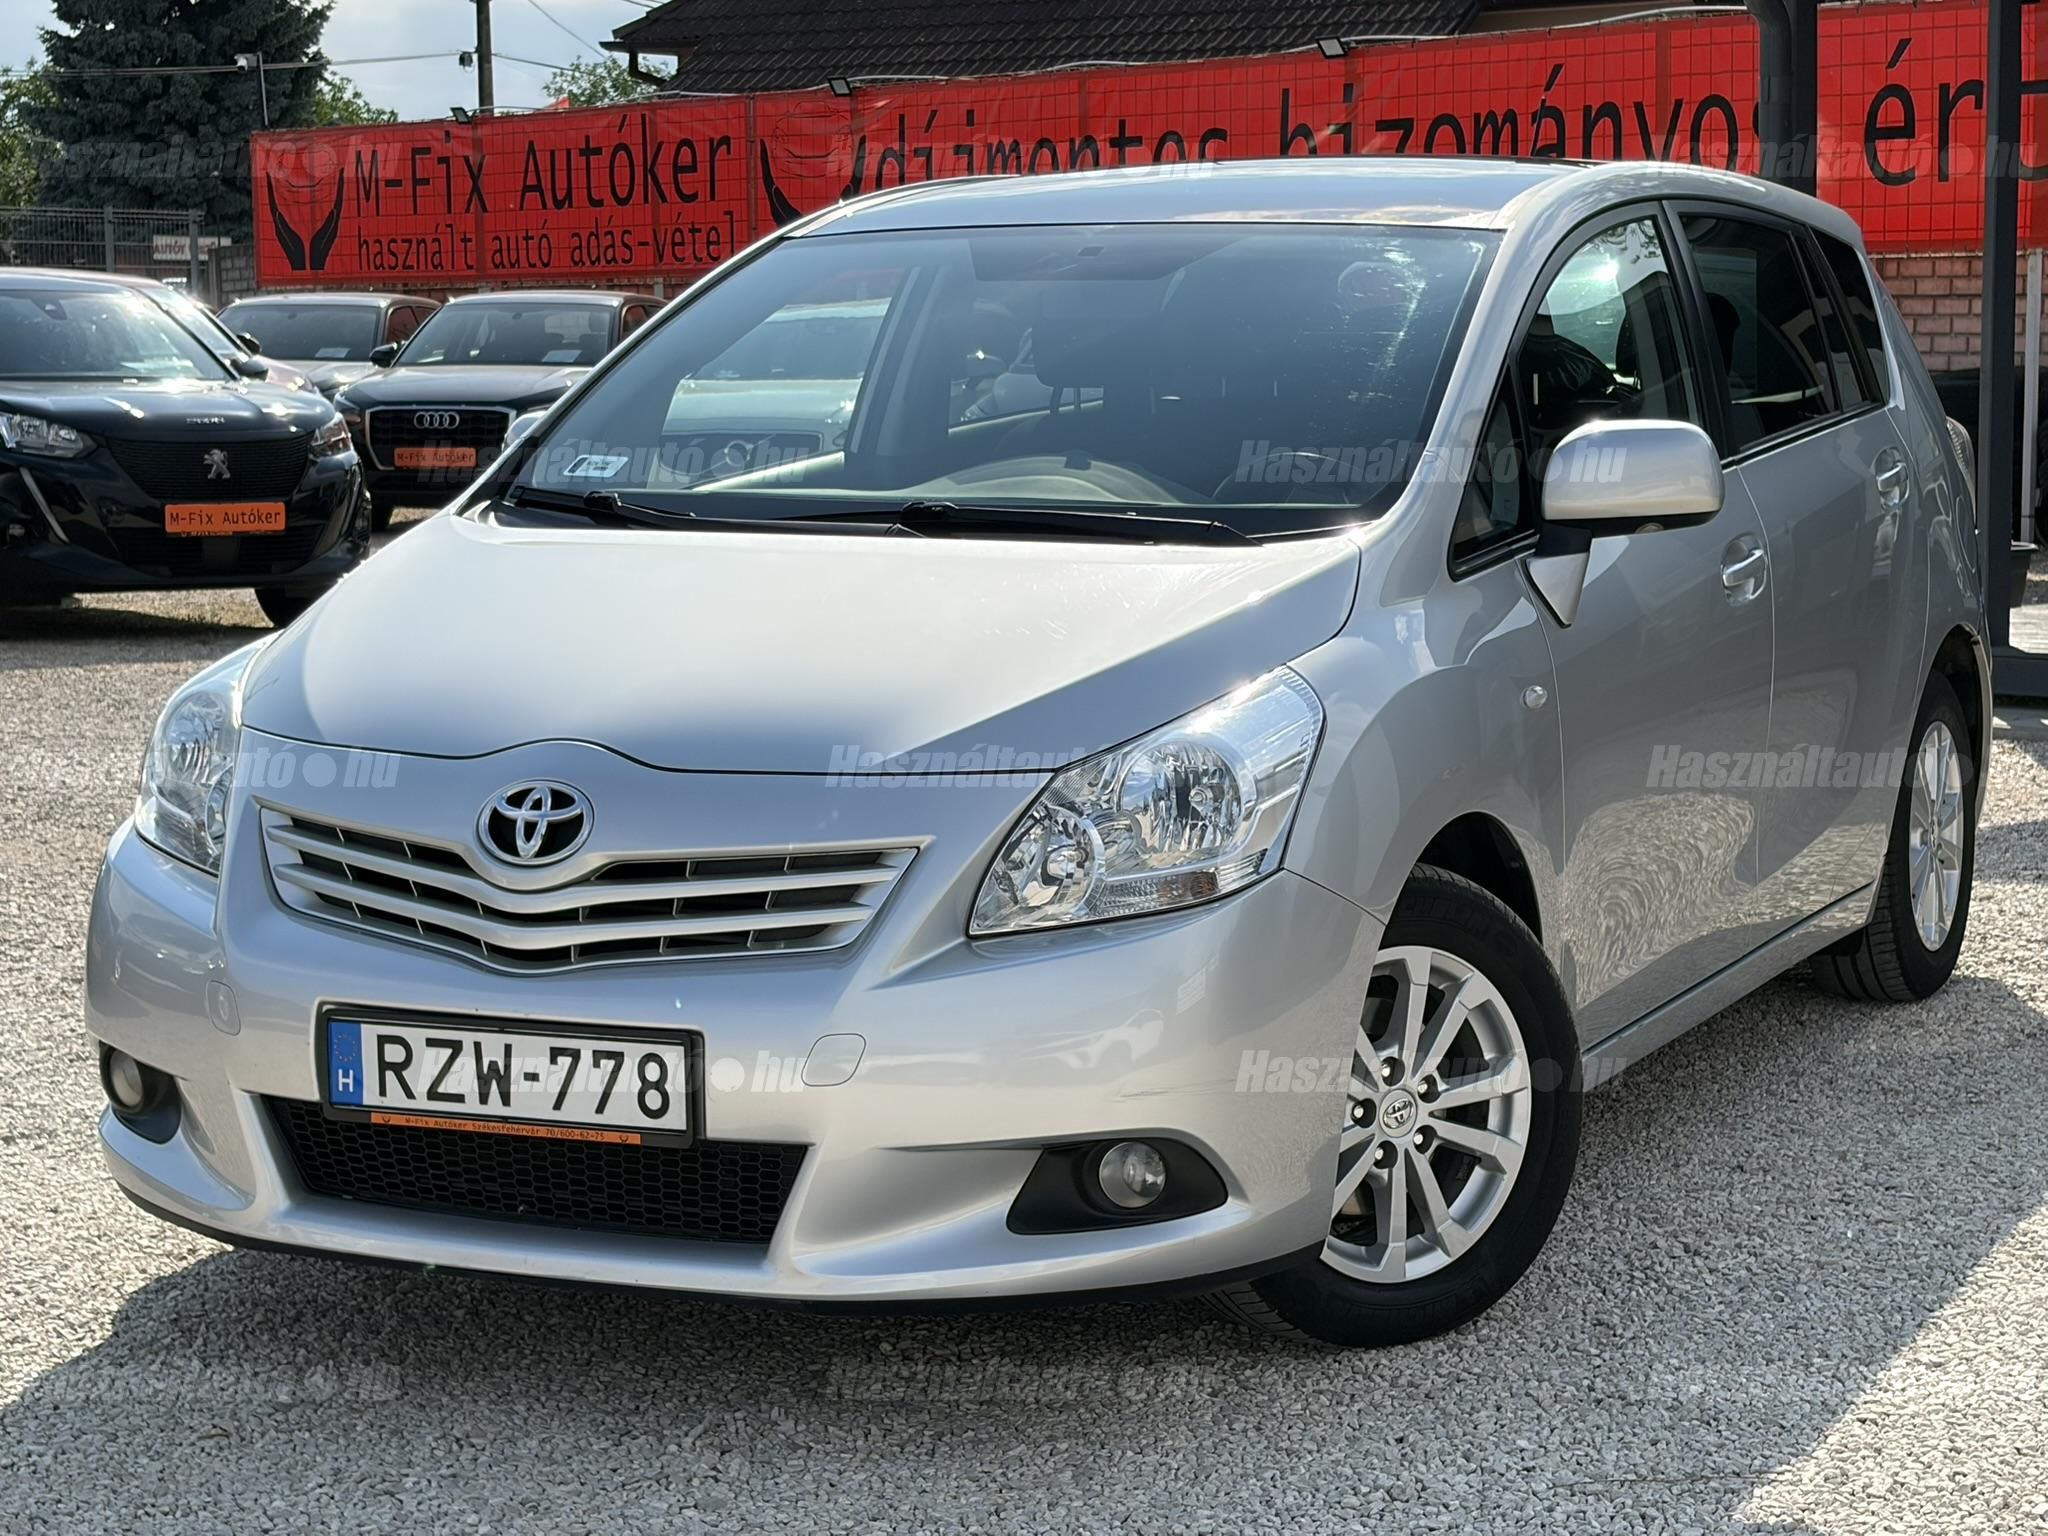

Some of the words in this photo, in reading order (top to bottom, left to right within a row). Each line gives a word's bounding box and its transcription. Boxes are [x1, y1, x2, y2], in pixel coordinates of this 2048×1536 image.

[355, 130, 489, 218] M-Fix
[519, 112, 732, 212] Autóker
[357, 222, 475, 272] használt
[490, 218, 553, 270] autó
[569, 209, 737, 267] adás-vétel
[169, 509, 214, 526] M-Fix
[222, 507, 281, 525] Autóker
[337, 1069, 354, 1093] H
[376, 1033, 671, 1120] RZW-778
